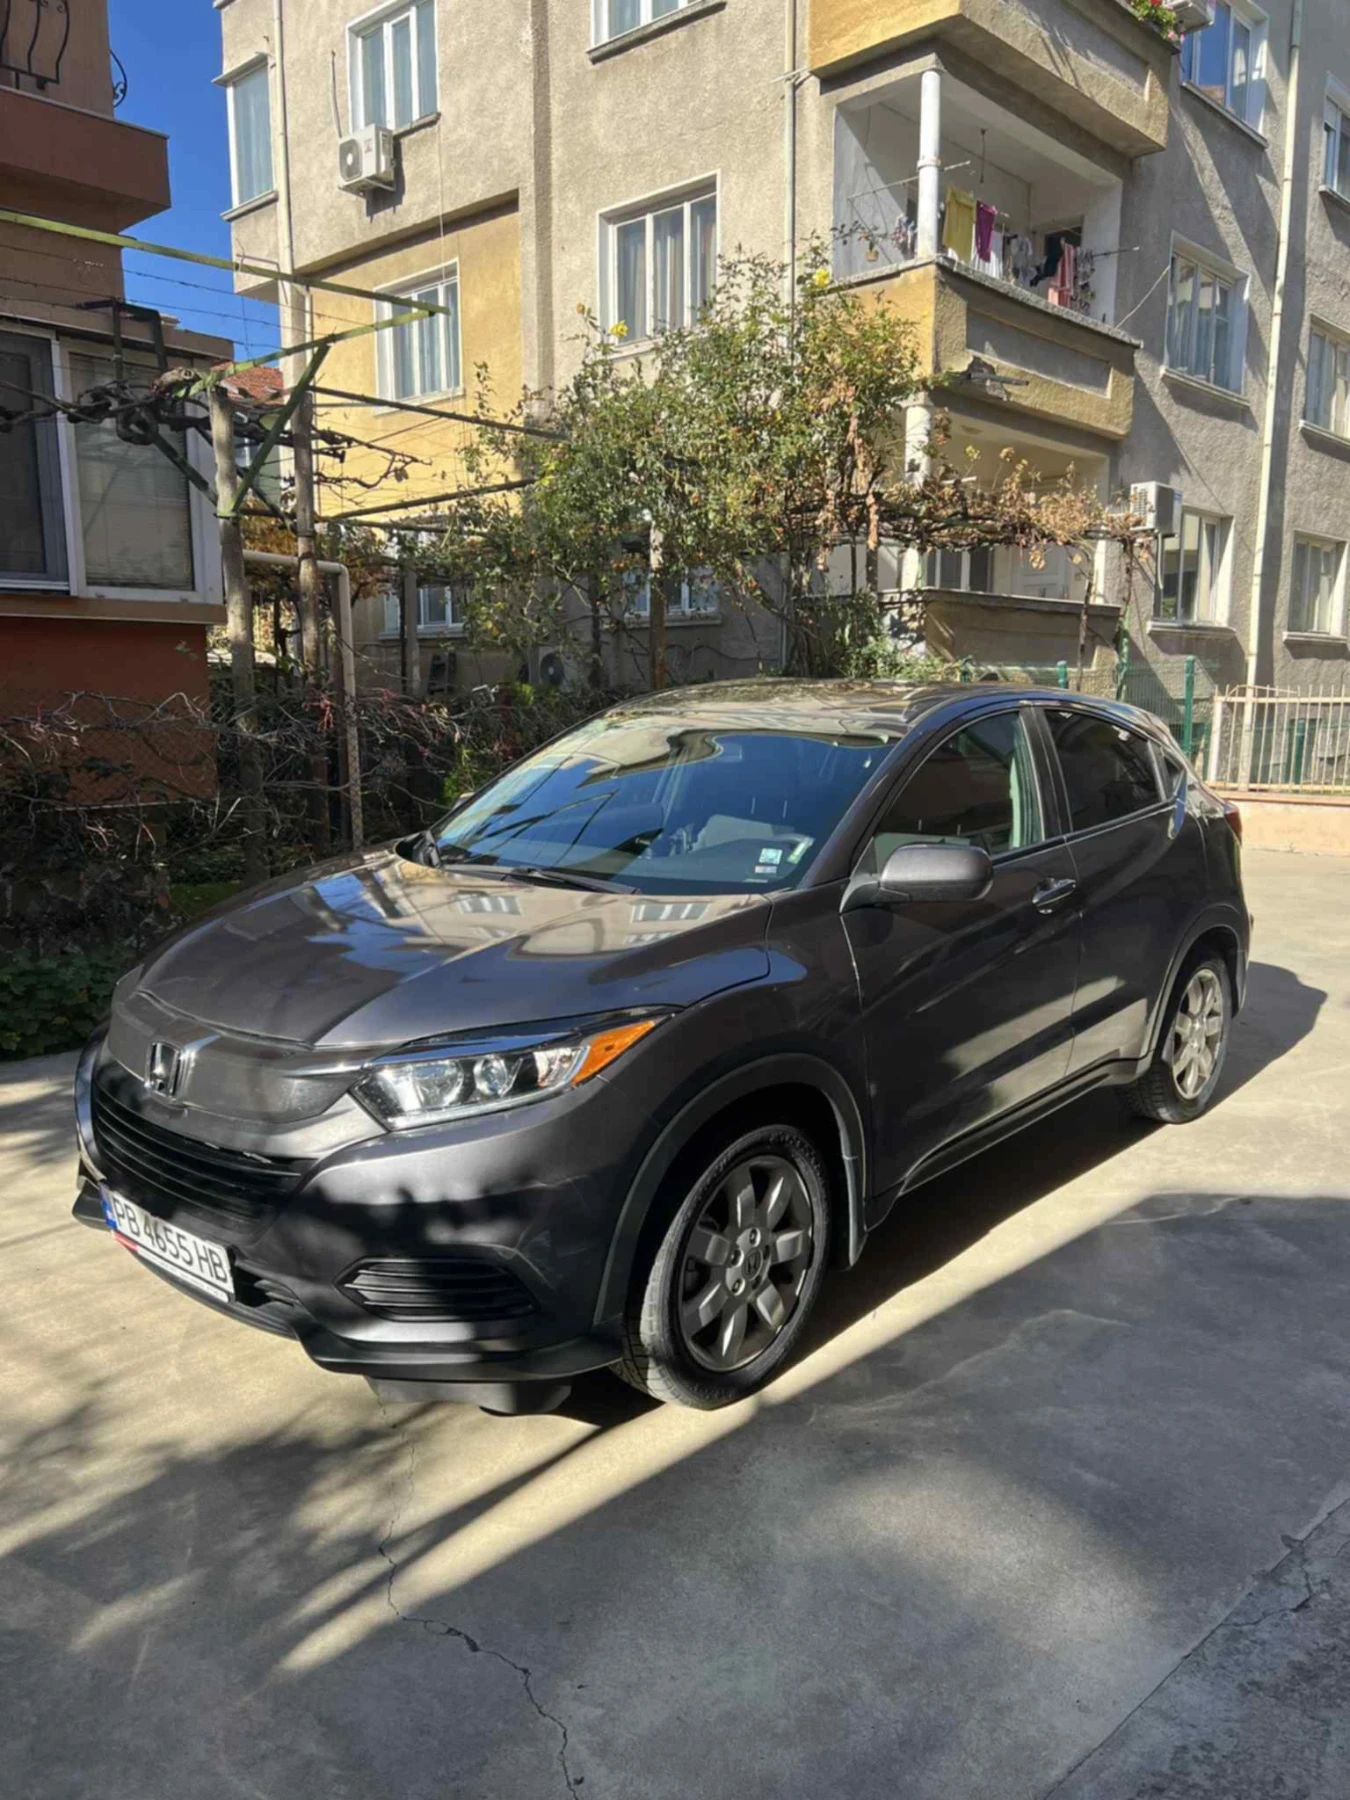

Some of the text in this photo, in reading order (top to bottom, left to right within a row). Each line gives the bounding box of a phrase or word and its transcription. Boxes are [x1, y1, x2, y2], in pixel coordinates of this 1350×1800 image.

[113, 1197, 140, 1238] PB
[144, 1214, 193, 1267] 4655
[193, 1239, 228, 1284] HB
